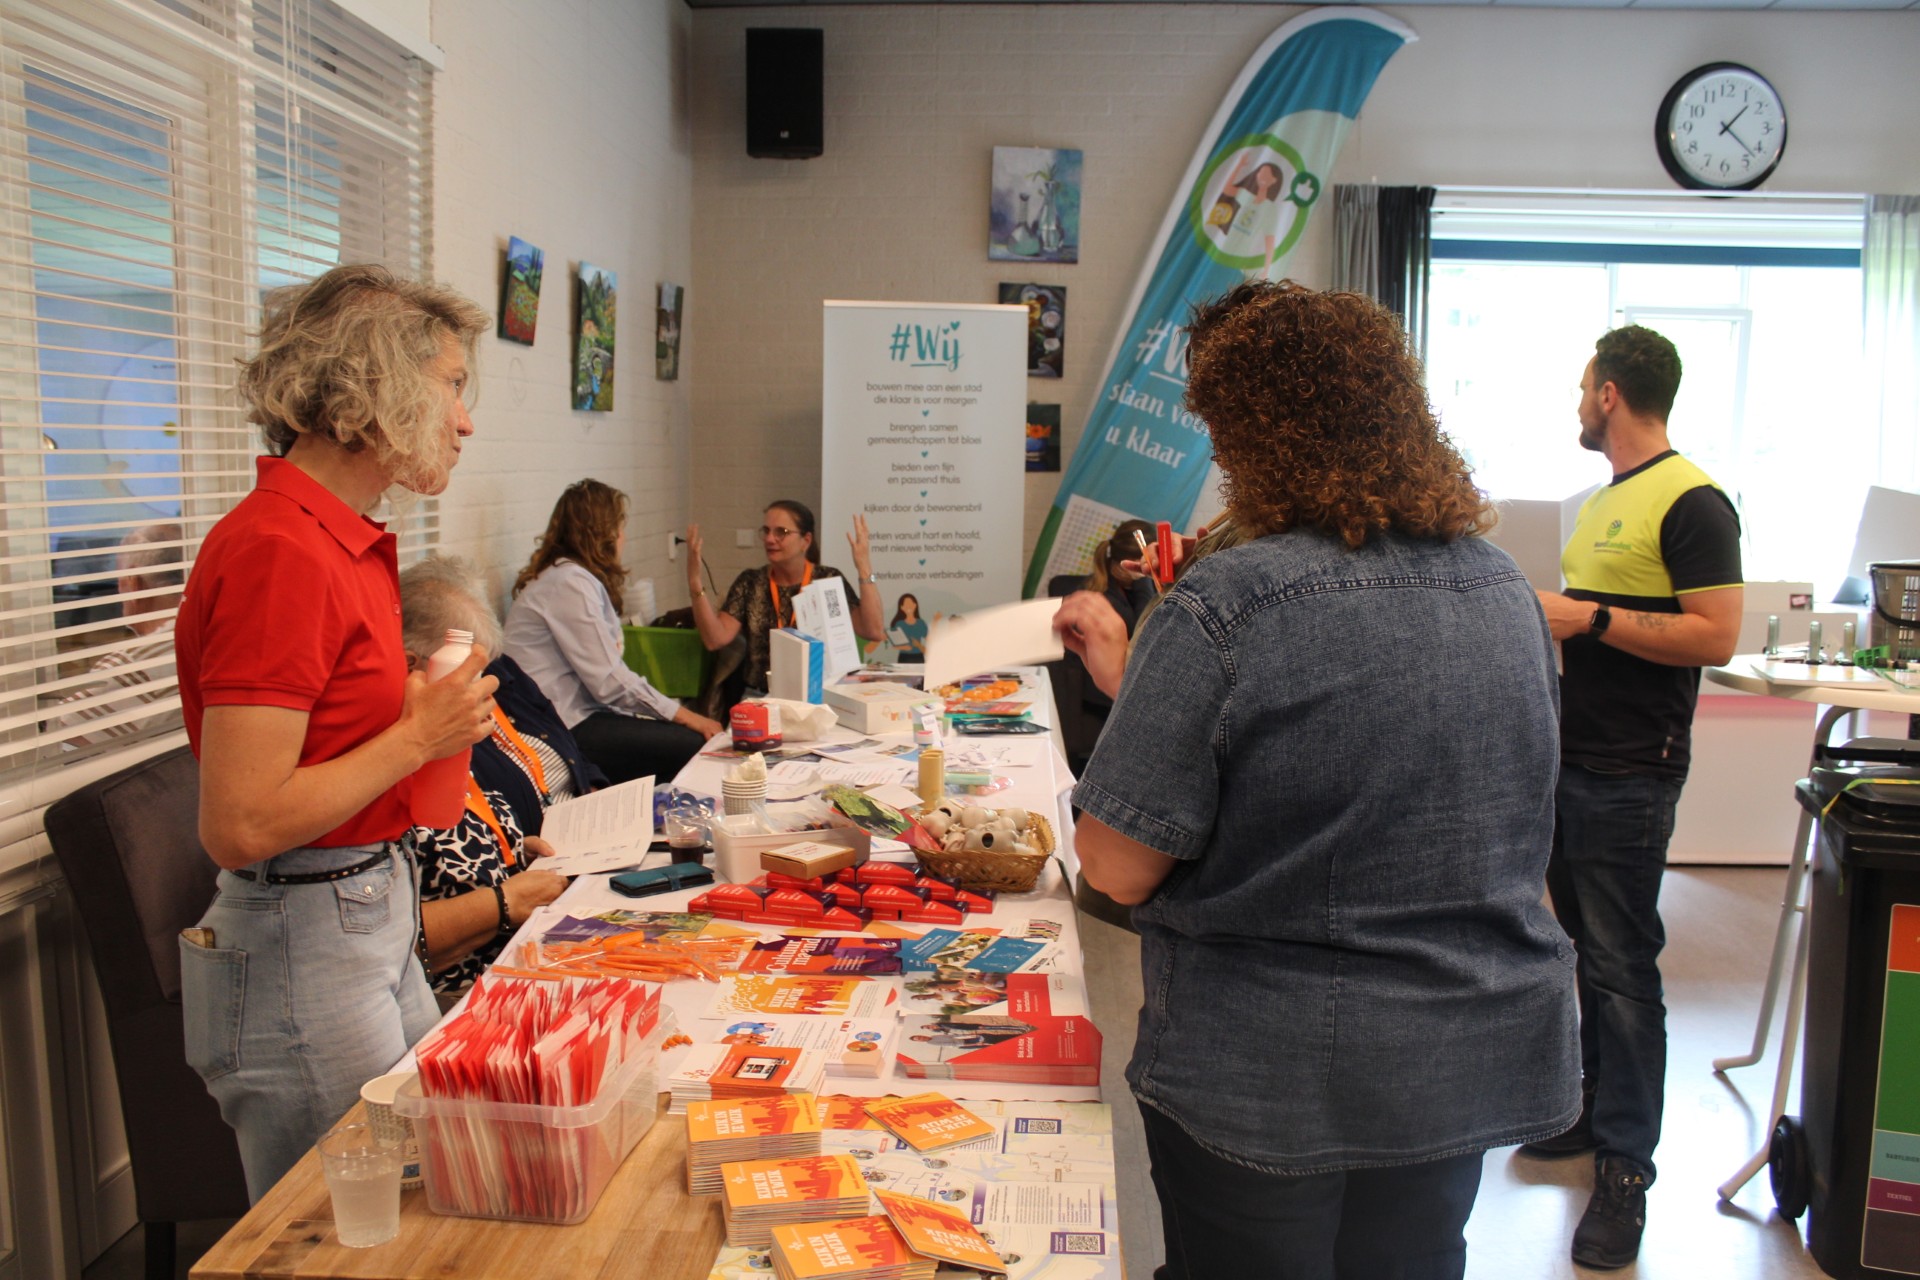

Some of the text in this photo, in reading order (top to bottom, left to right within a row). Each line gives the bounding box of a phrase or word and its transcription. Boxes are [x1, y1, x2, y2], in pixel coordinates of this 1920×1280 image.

[1704, 90, 1716, 103] 11
[1720, 84, 1735, 98] 12
[1743, 89, 1749, 102] 1
[1689, 105, 1705, 118] 10
[1754, 101, 1763, 115] 2
[1682, 121, 1693, 134] 9
[1762, 121, 1771, 135] 3
[1688, 141, 1698, 154] 8
[1754, 141, 1762, 154] 4
[1704, 154, 1712, 168] 7
[1720, 160, 1730, 173] 6
[1741, 154, 1750, 169] 5
[889, 321, 964, 372] #Wij
[866, 382, 982, 393] bouwen mee aan een stad
[873, 395, 887, 404] die
[889, 395, 912, 404] klaar
[913, 395, 921, 404] is
[943, 397, 977, 407] morgen
[1108, 380, 1166, 418] staan
[889, 423, 958, 433] brengen samen
[867, 436, 981, 446] gemeenschappen tot bloei
[1105, 425, 1186, 469] u klaar
[891, 463, 955, 473] bieden een fijn
[887, 475, 961, 486] en passend thuis
[864, 503, 982, 514] kijken door de bewonersbril
[894, 531, 921, 540] vanuit
[923, 531, 940, 540] hart
[955, 530, 981, 540] hoofd,
[871, 543, 973, 554] met nieuwe technologie
[906, 572, 927, 580] onze
[929, 571, 984, 581] verbindingen
[766, 939, 802, 972] Cultuur
[792, 937, 822, 966] maand
[713, 1110, 730, 1135] KIJK IN
[729, 1108, 746, 1133] JE WIJK
[917, 1113, 968, 1130] JE WIJK
[927, 1118, 976, 1135] KIJK IN
[751, 1172, 773, 1199] KIJK IN
[767, 1169, 789, 1198] JE WIJK
[922, 1227, 982, 1246] JE WIJK
[807, 1236, 838, 1268] KIJK IN
[823, 1232, 854, 1265] JE WIJK
[932, 1236, 989, 1254] KIJK IN
